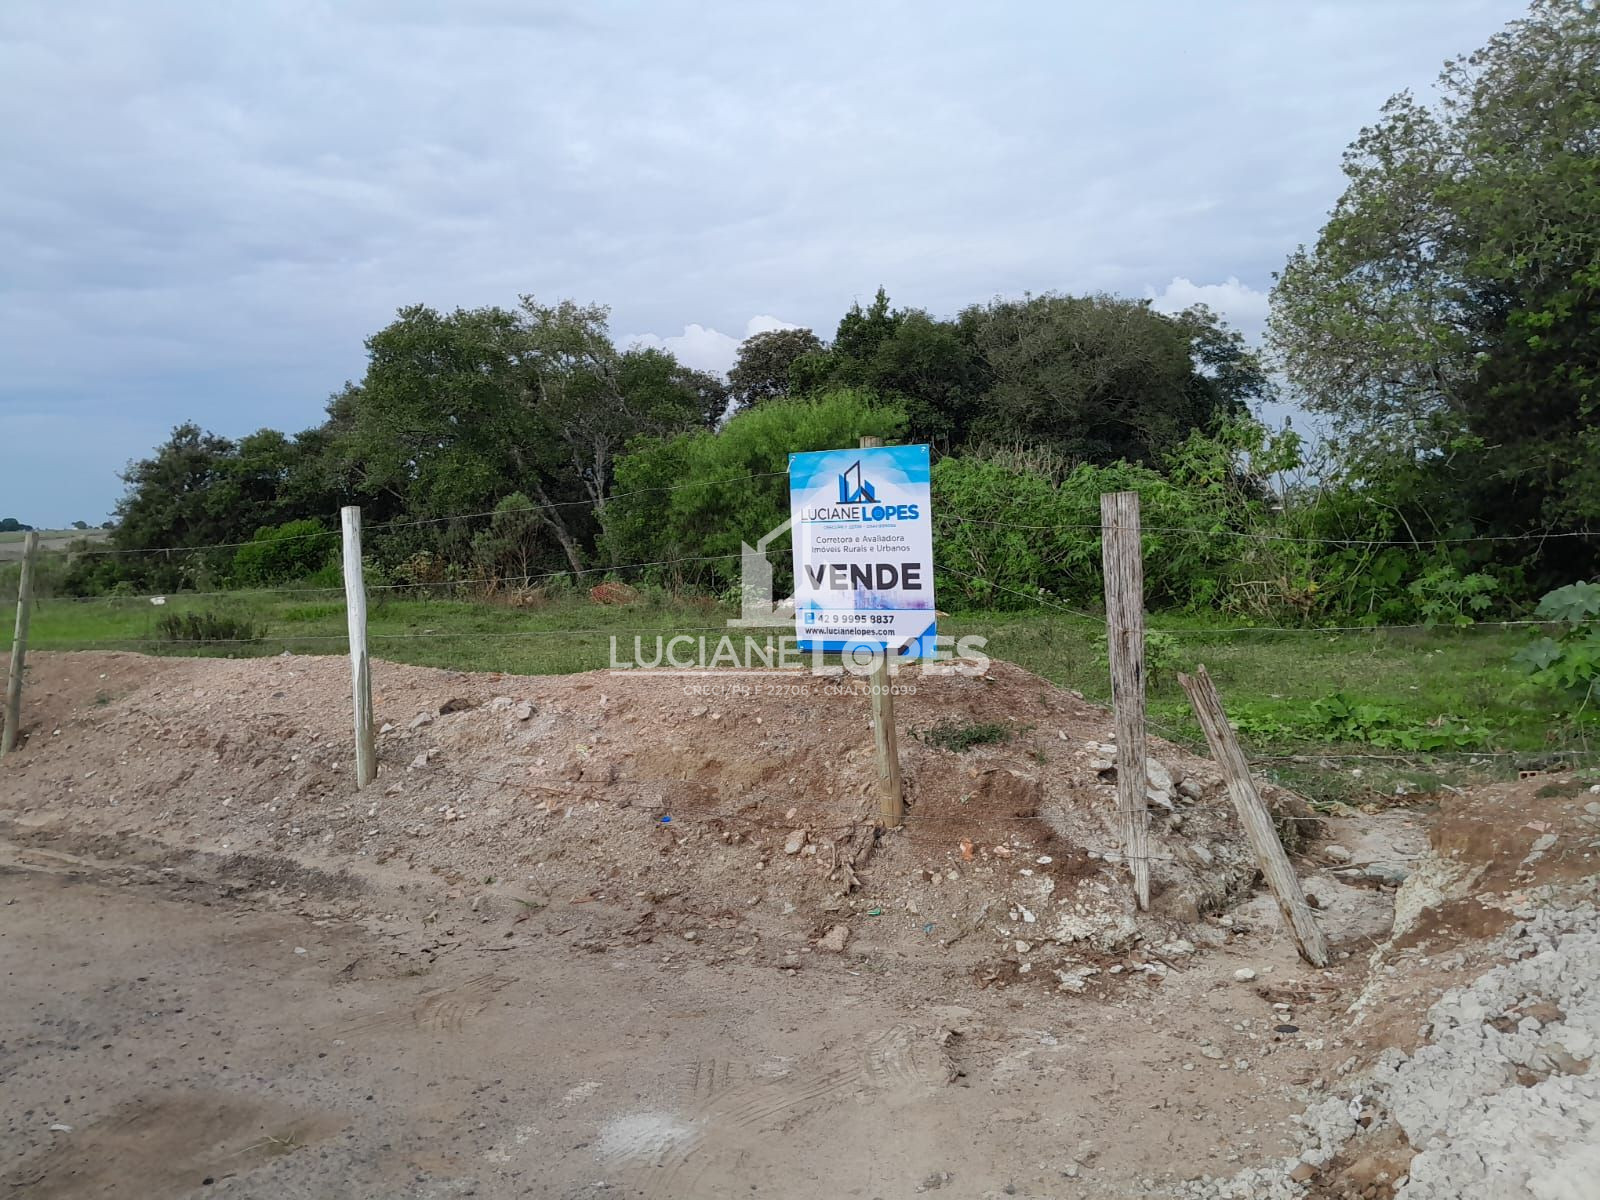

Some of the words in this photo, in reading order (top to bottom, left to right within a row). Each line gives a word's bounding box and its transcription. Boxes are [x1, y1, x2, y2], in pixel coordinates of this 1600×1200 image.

[801, 507, 859, 521] LUCIANE
[862, 504, 919, 521] LOPES
[816, 536, 853, 544] Corretora
[811, 544, 841, 553] Imóveis
[843, 544, 867, 552] Rurais
[876, 544, 910, 552] Urbanos
[804, 562, 922, 590] VENDE
[818, 615, 830, 623] 42
[842, 614, 867, 623] 9995
[805, 627, 895, 636] www.lucianelopes.com
